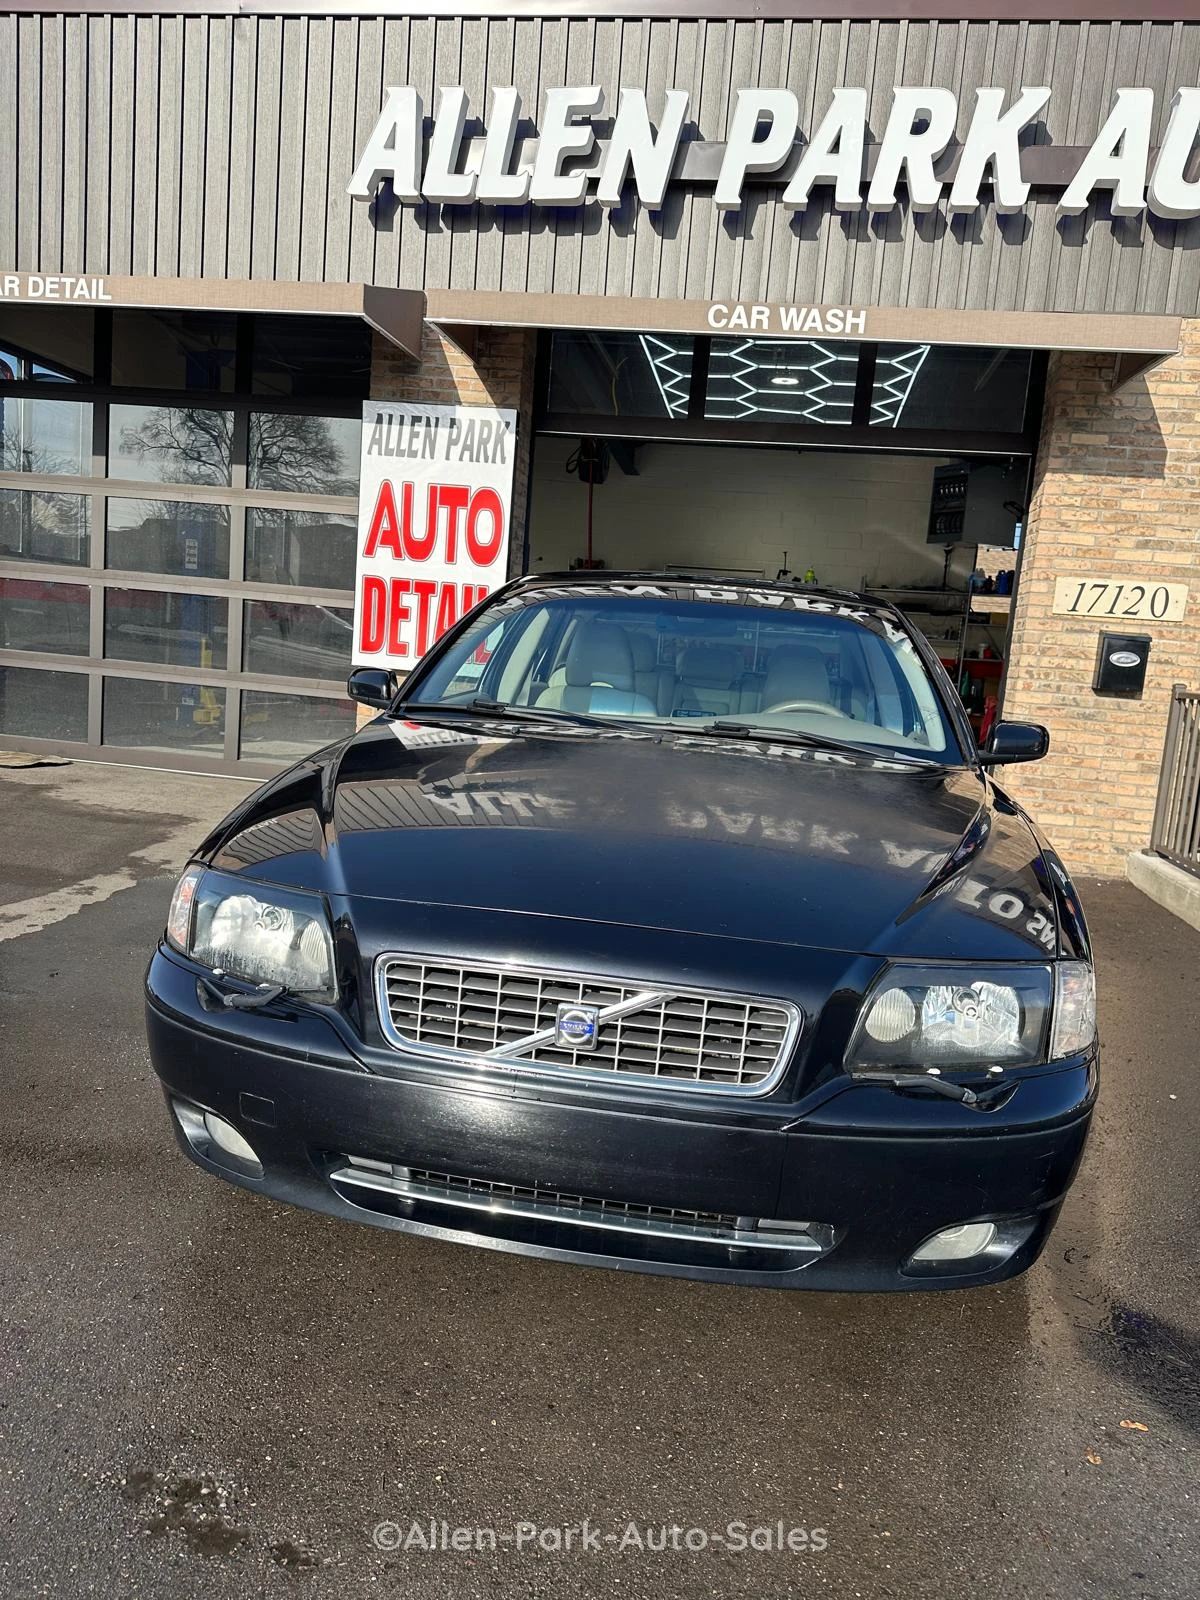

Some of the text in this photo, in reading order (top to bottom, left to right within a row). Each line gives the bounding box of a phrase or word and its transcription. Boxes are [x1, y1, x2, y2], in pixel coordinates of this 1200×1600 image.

[346, 85, 689, 210] ALLEN
[715, 87, 1051, 213] PARK
[28, 276, 112, 300] DETAIL
[707, 304, 867, 334] CAR WASH
[367, 413, 511, 464] ALLEN PARK
[362, 479, 505, 567] AUTO
[1067, 582, 1170, 619] 17120
